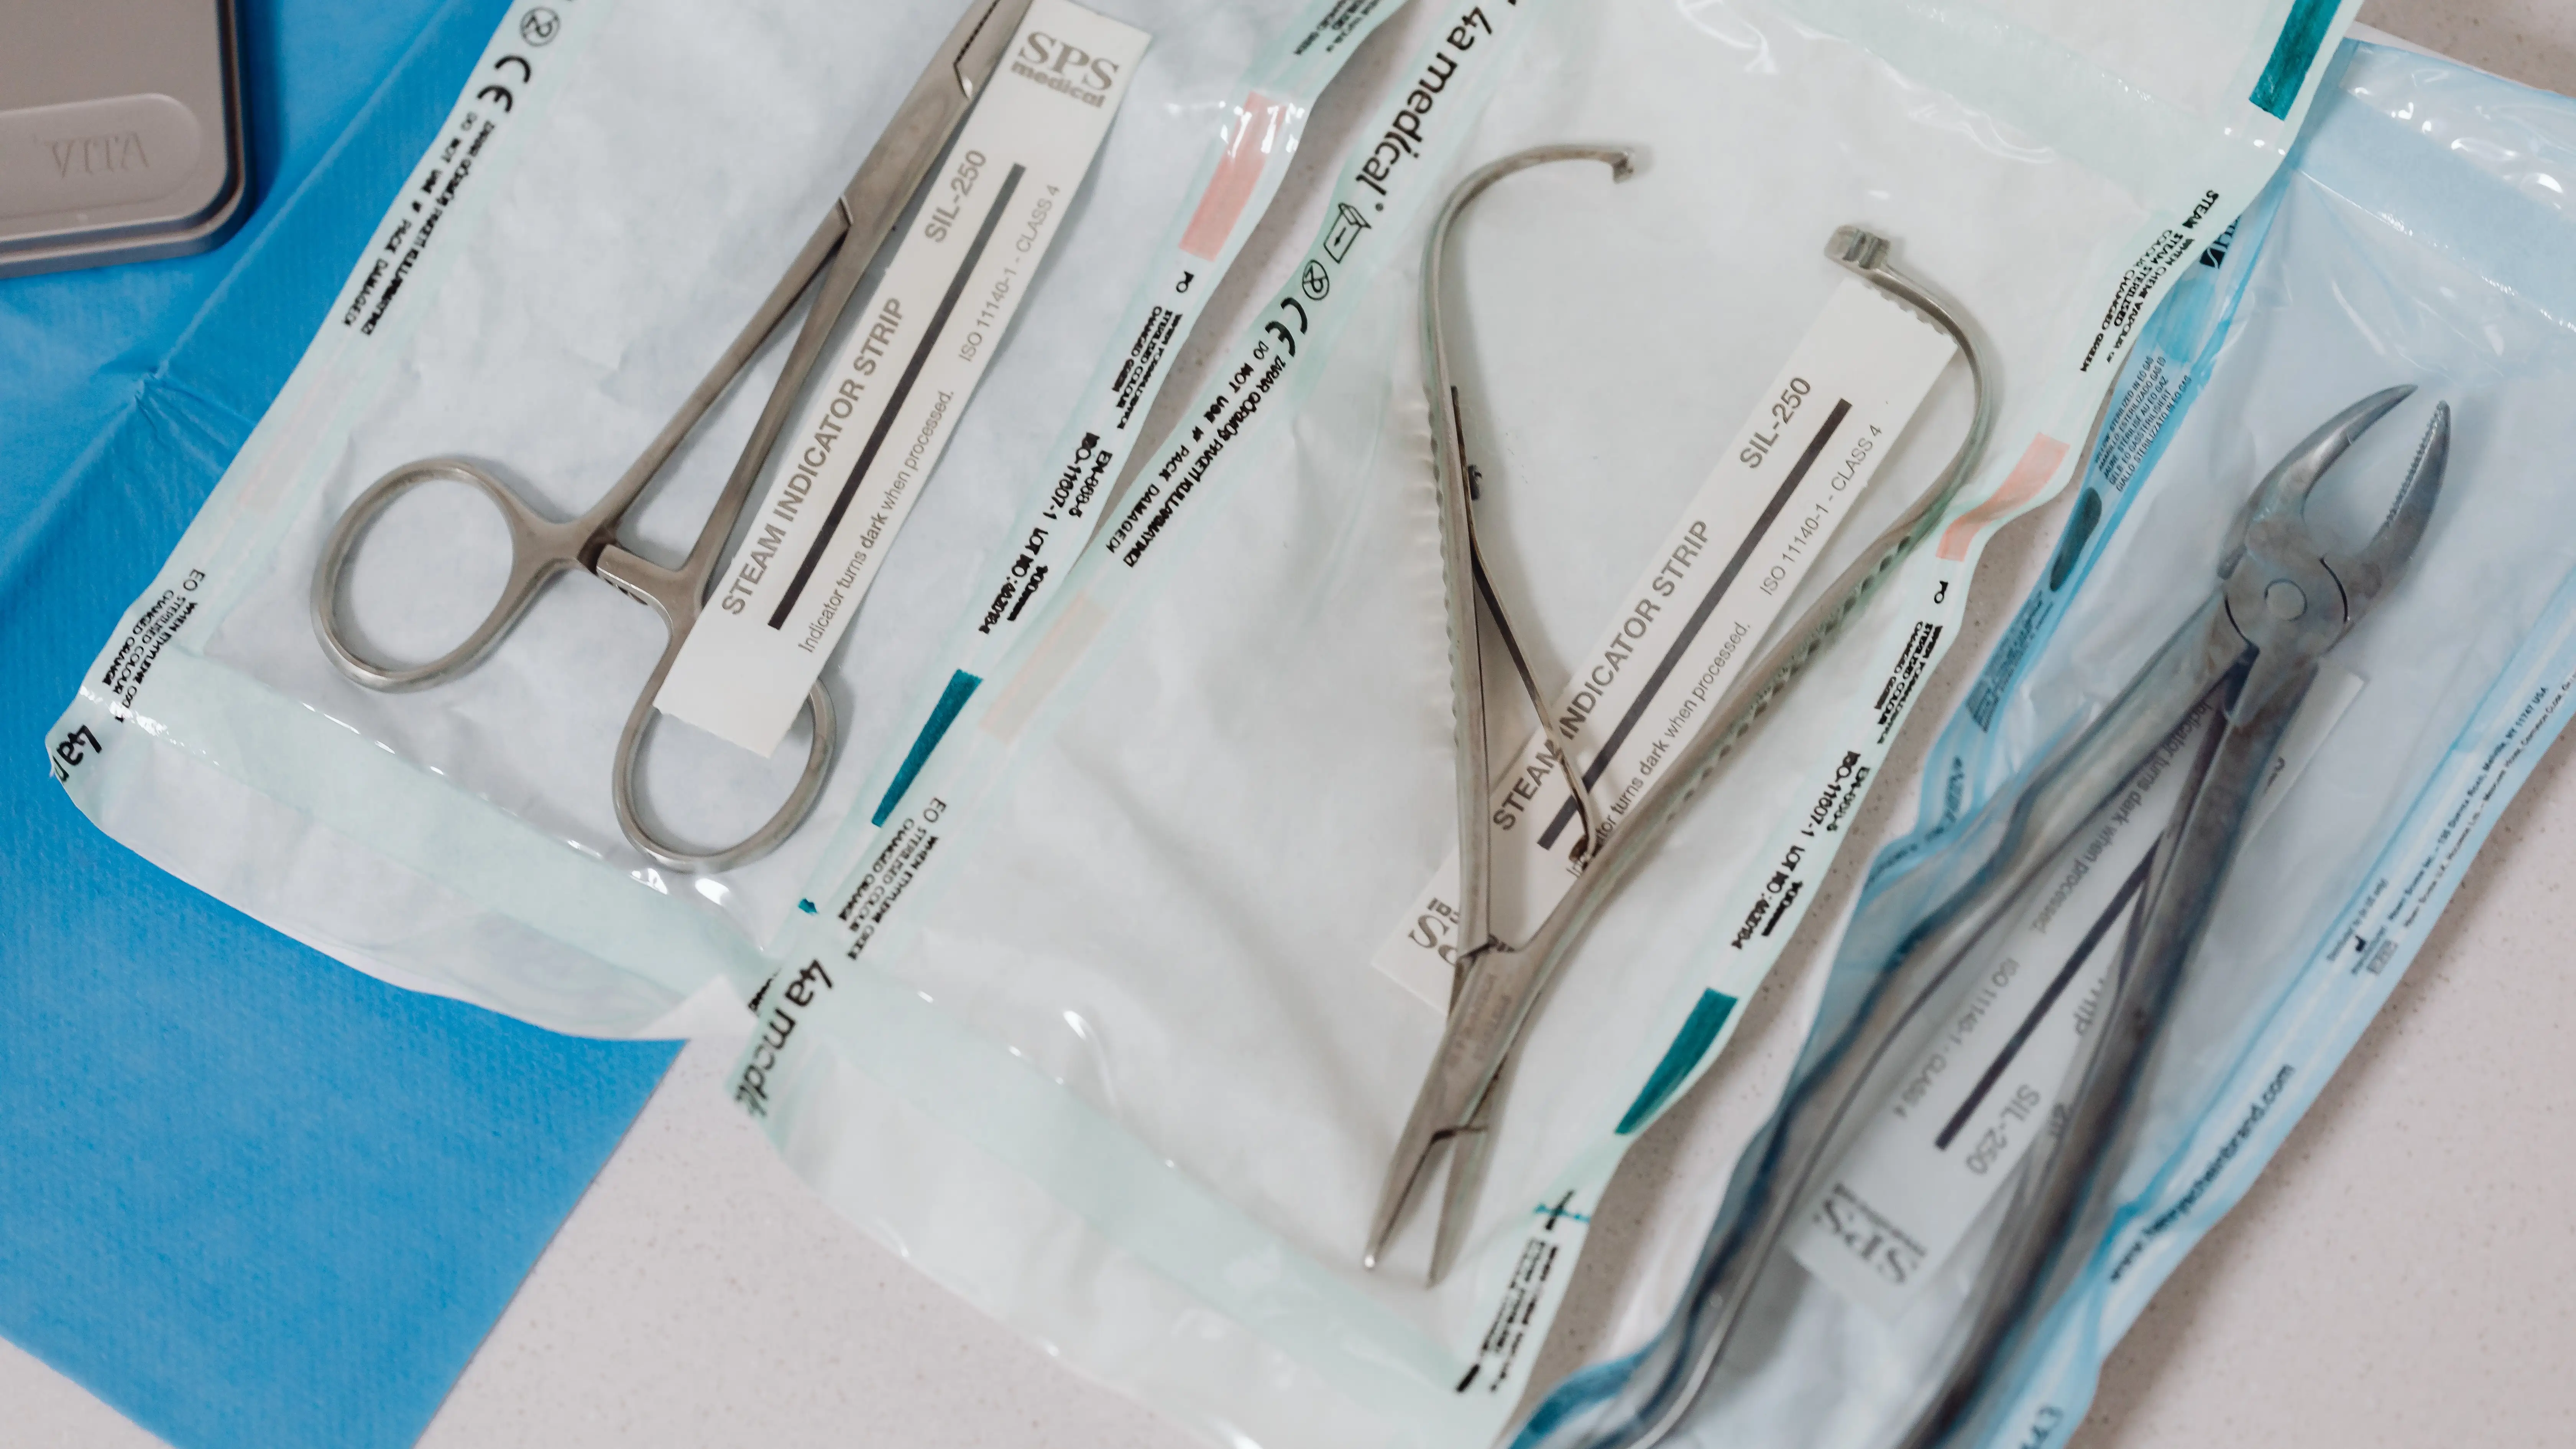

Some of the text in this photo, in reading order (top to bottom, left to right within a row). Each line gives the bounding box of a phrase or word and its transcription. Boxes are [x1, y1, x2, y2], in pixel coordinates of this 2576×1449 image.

[1446, 7, 1492, 51] 4a
[1018, 31, 1119, 90] SPS
[1253, 340, 1269, 360] DO
[721, 150, 986, 615] STEAM INDICATOR STRIP SIL-250
[798, 588, 844, 653] Indicator
[836, 551, 867, 589] turns
[860, 513, 888, 549] dark
[881, 471, 911, 510] when
[904, 391, 954, 471] processed.
[958, 332, 983, 362] ISO
[976, 268, 1016, 327] 11140-1
[1015, 198, 1053, 253] CLASS
[1046, 185, 1060, 196] 4
[1158, 445, 1189, 481] PACK
[183, 569, 206, 591] EO
[1552, 595, 1663, 740] INDICATOR
[1652, 521, 1708, 597] STRIP
[1740, 377, 1811, 468] SIL-250
[1610, 778, 1643, 816] turns
[1640, 740, 1669, 775] dark
[1664, 700, 1697, 738] when
[1691, 621, 1748, 702] processed.
[1760, 565, 1786, 596] ISO
[1782, 503, 1829, 562] 11140-1
[1831, 438, 1873, 491] CLASS
[1870, 425, 1882, 437] 4
[2133, 752, 2171, 794] turns
[923, 797, 947, 823] EO
[2108, 788, 2146, 830] dark
[2079, 822, 2121, 868] when
[784, 959, 833, 1007] 4a
[1988, 954, 2023, 991] ISO
